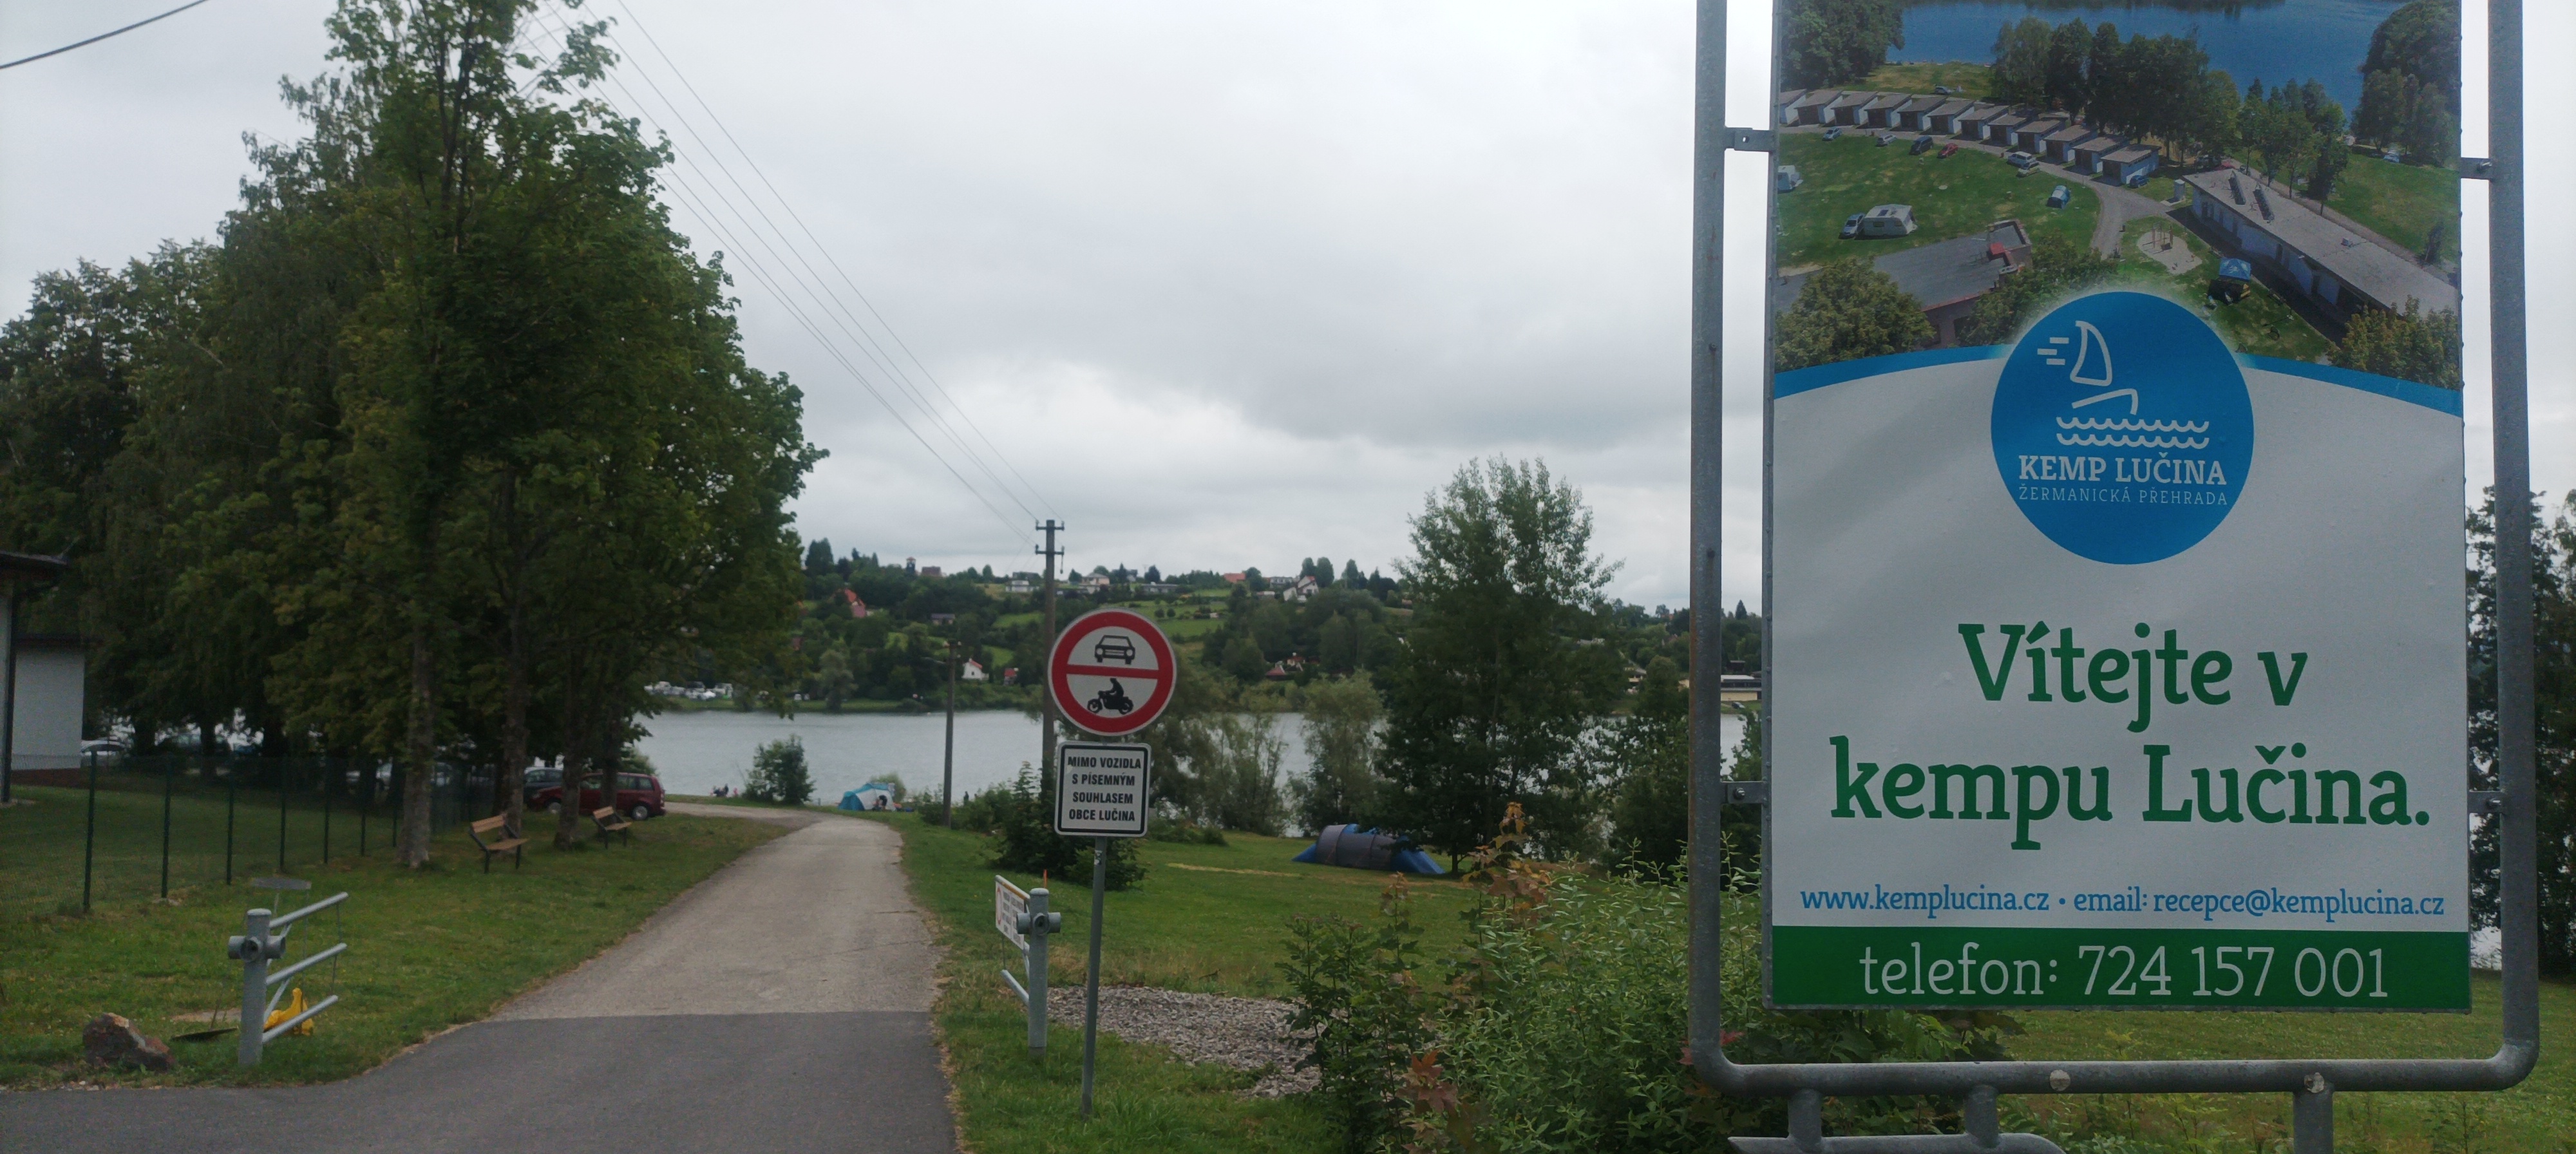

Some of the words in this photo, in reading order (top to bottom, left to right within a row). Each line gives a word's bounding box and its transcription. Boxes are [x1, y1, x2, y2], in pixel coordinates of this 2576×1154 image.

[2018, 455, 2107, 482] KEMP
[2115, 451, 2227, 486] LUČINA
[2018, 483, 2131, 503] ŽERMANICKÁ
[2139, 486, 2228, 506] PŘEHRADA
[1958, 620, 2233, 733] Vítejte
[2257, 651, 2308, 706] v
[1067, 756, 1097, 768] MIMO
[1100, 757, 1141, 769] VOZIDLA
[1072, 773, 1078, 784] S
[1081, 771, 1135, 786] PÍSEMNÝM
[1828, 735, 2112, 851] kempu
[2142, 742, 2430, 827] Lučina.
[1072, 791, 1133, 804] SOUHLASEM
[1068, 809, 1095, 820] OBCE
[1099, 808, 1135, 822] LUČINA
[1799, 884, 2050, 919] www.kemplucina.cz
[2073, 886, 2148, 913] email:
[2153, 889, 2445, 924] recepce@kemplucina.cz
[1859, 941, 2058, 996] telefon:
[2078, 945, 2172, 997] 724
[2191, 946, 2275, 998] 157
[2293, 946, 2389, 999] 001
